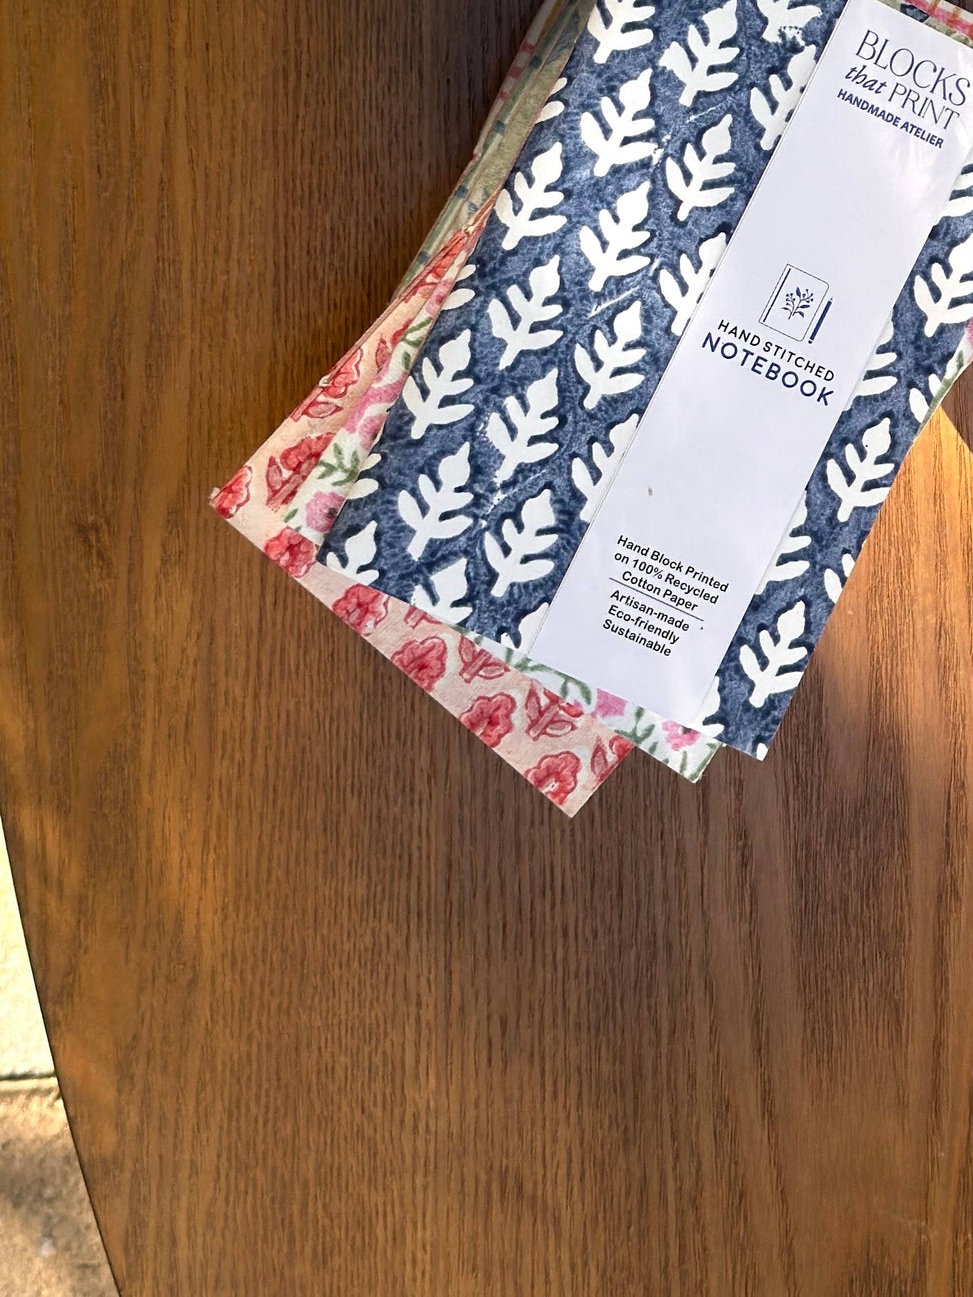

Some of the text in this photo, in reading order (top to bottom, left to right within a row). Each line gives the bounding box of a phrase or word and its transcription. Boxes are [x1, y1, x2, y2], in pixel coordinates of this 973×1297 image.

[855, 29, 971, 106] BLOCKS
[837, 88, 944, 149] HANDMADE ATELIER
[845, 65, 960, 130] that PRINT
[702, 332, 834, 406] NOTEBOOK
[717, 319, 835, 382] HAND STITCHED
[614, 552, 719, 605] on 100% Recycled
[617, 534, 729, 592] Hand Block Printed
[622, 571, 698, 611] Cotton Paper
[602, 618, 671, 657] Sustainable
[608, 604, 680, 645] Eco-friendly
[610, 589, 690, 632] Artisan-made
